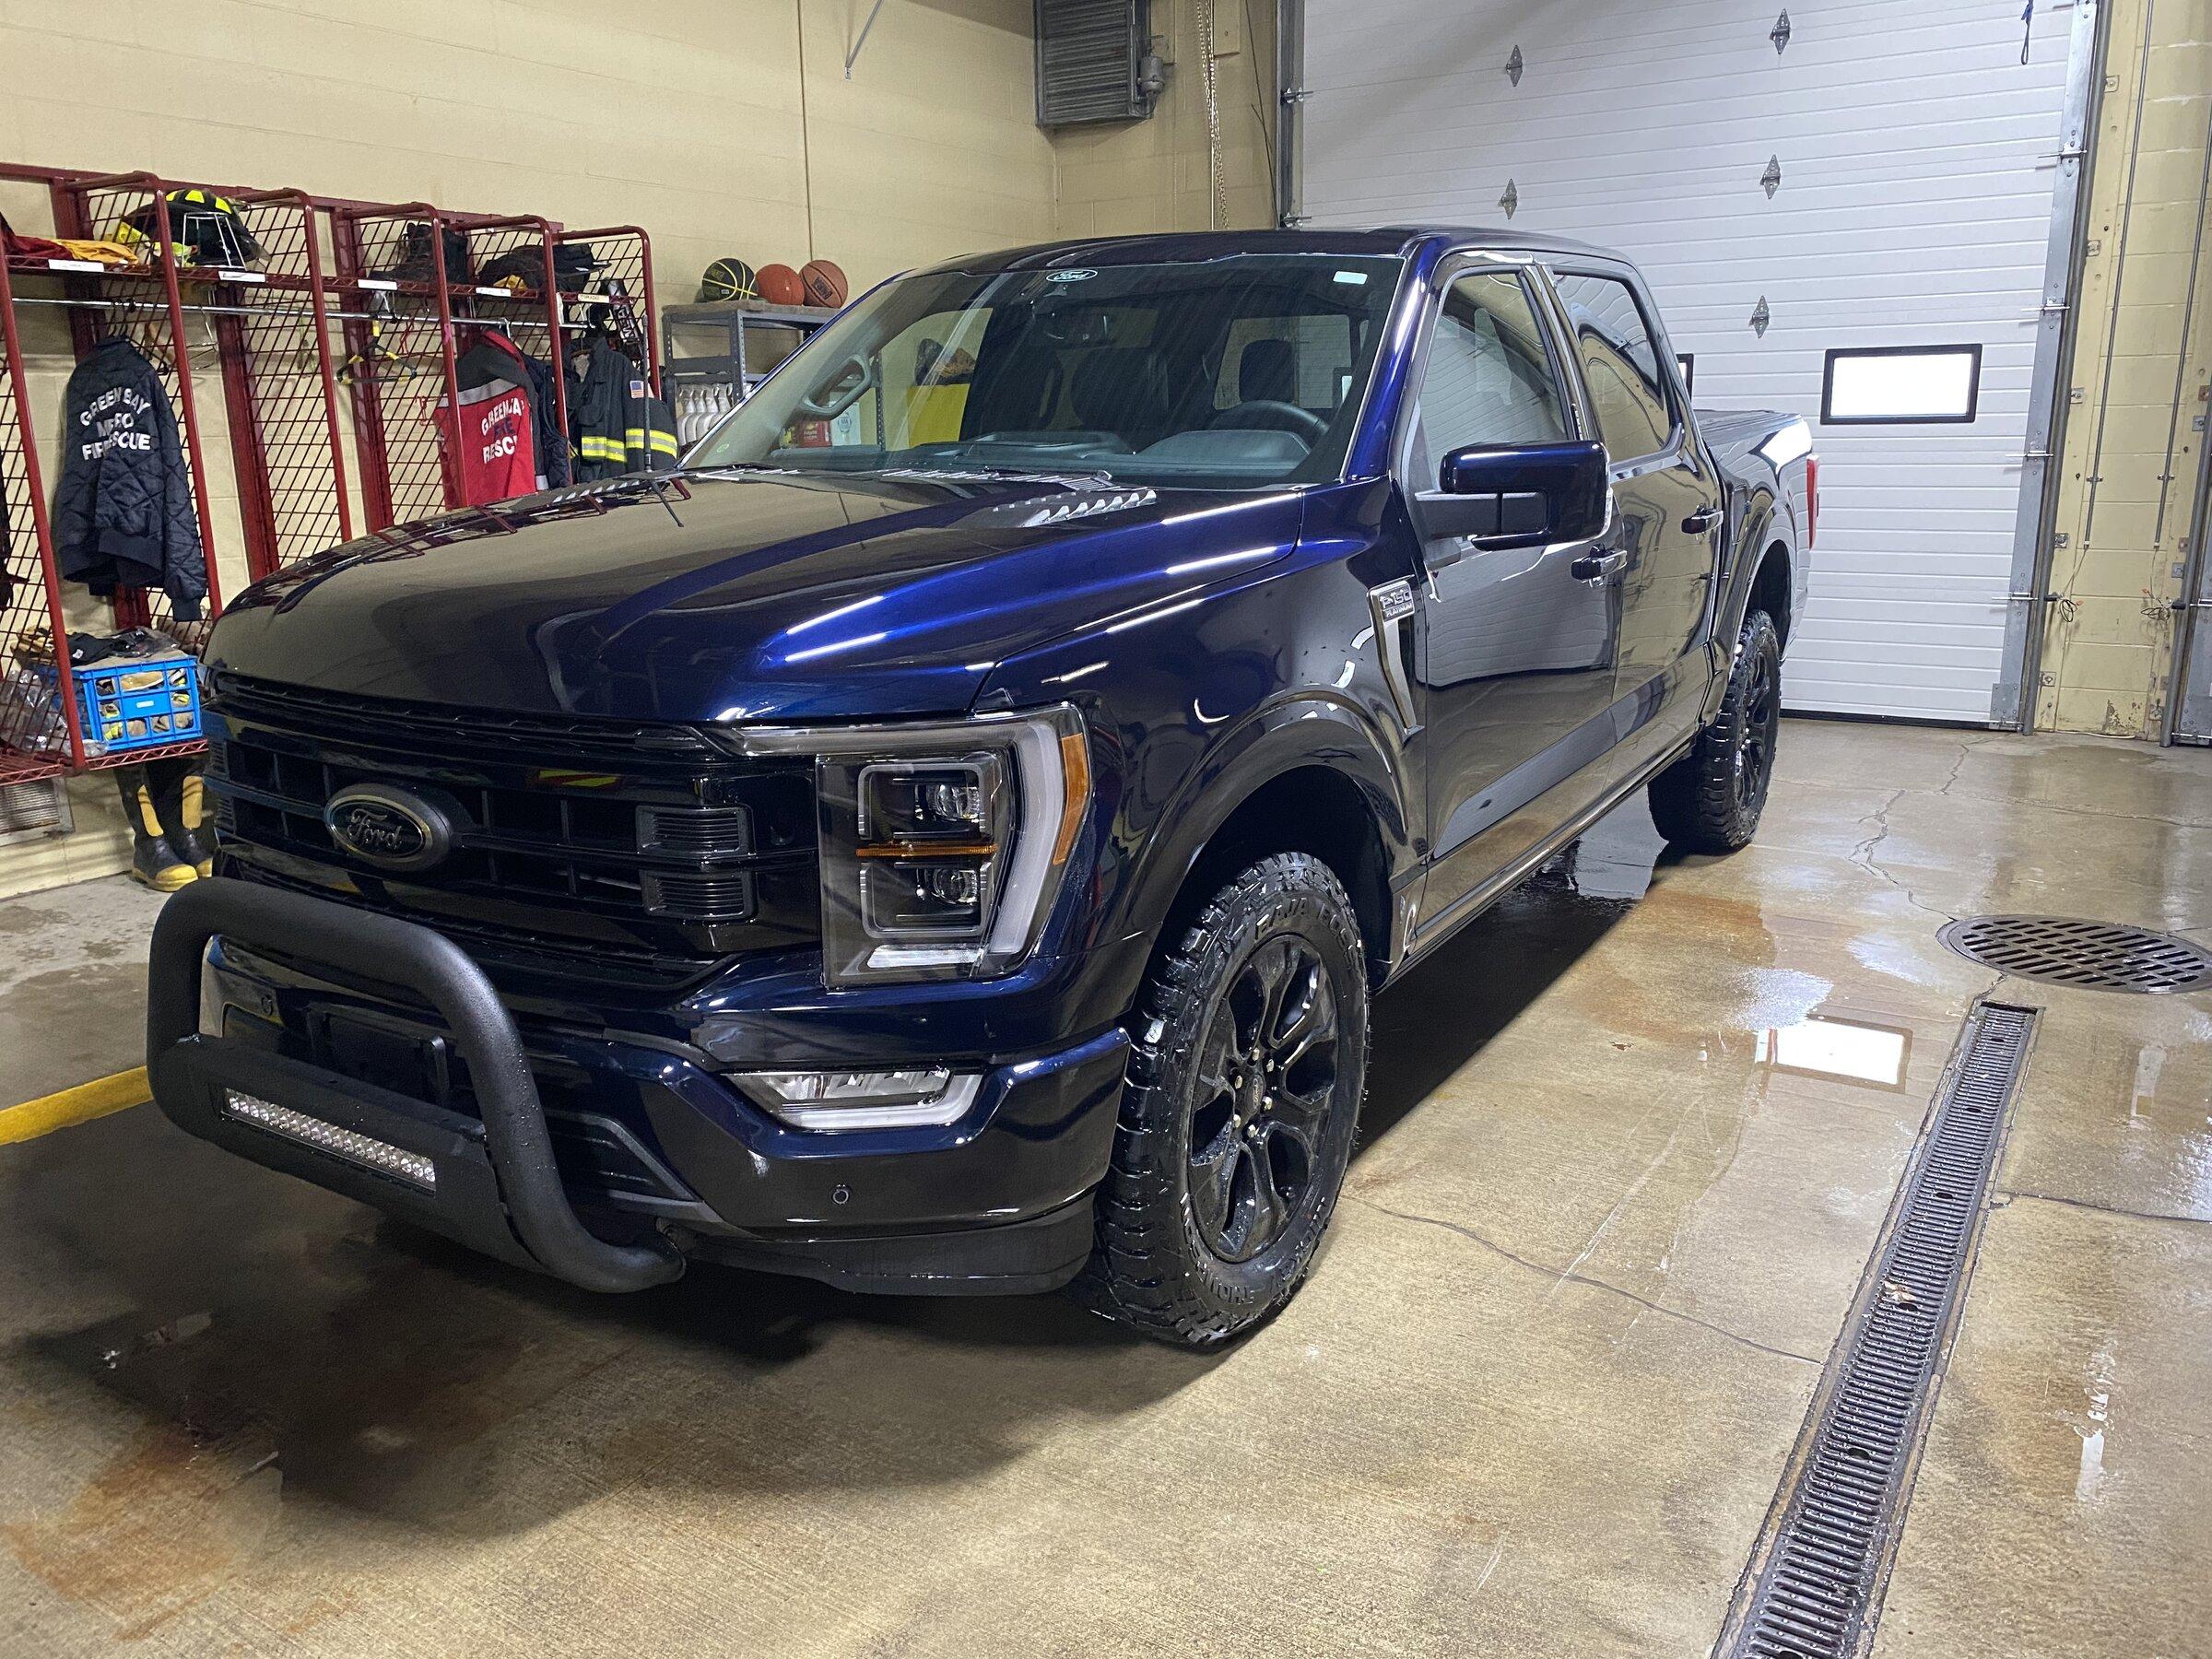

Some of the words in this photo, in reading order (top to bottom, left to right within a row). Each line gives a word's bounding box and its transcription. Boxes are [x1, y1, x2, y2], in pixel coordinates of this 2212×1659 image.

[80, 387, 122, 426] GREEN
[123, 388, 151, 414] BAY
[347, 808, 402, 850] Ford
